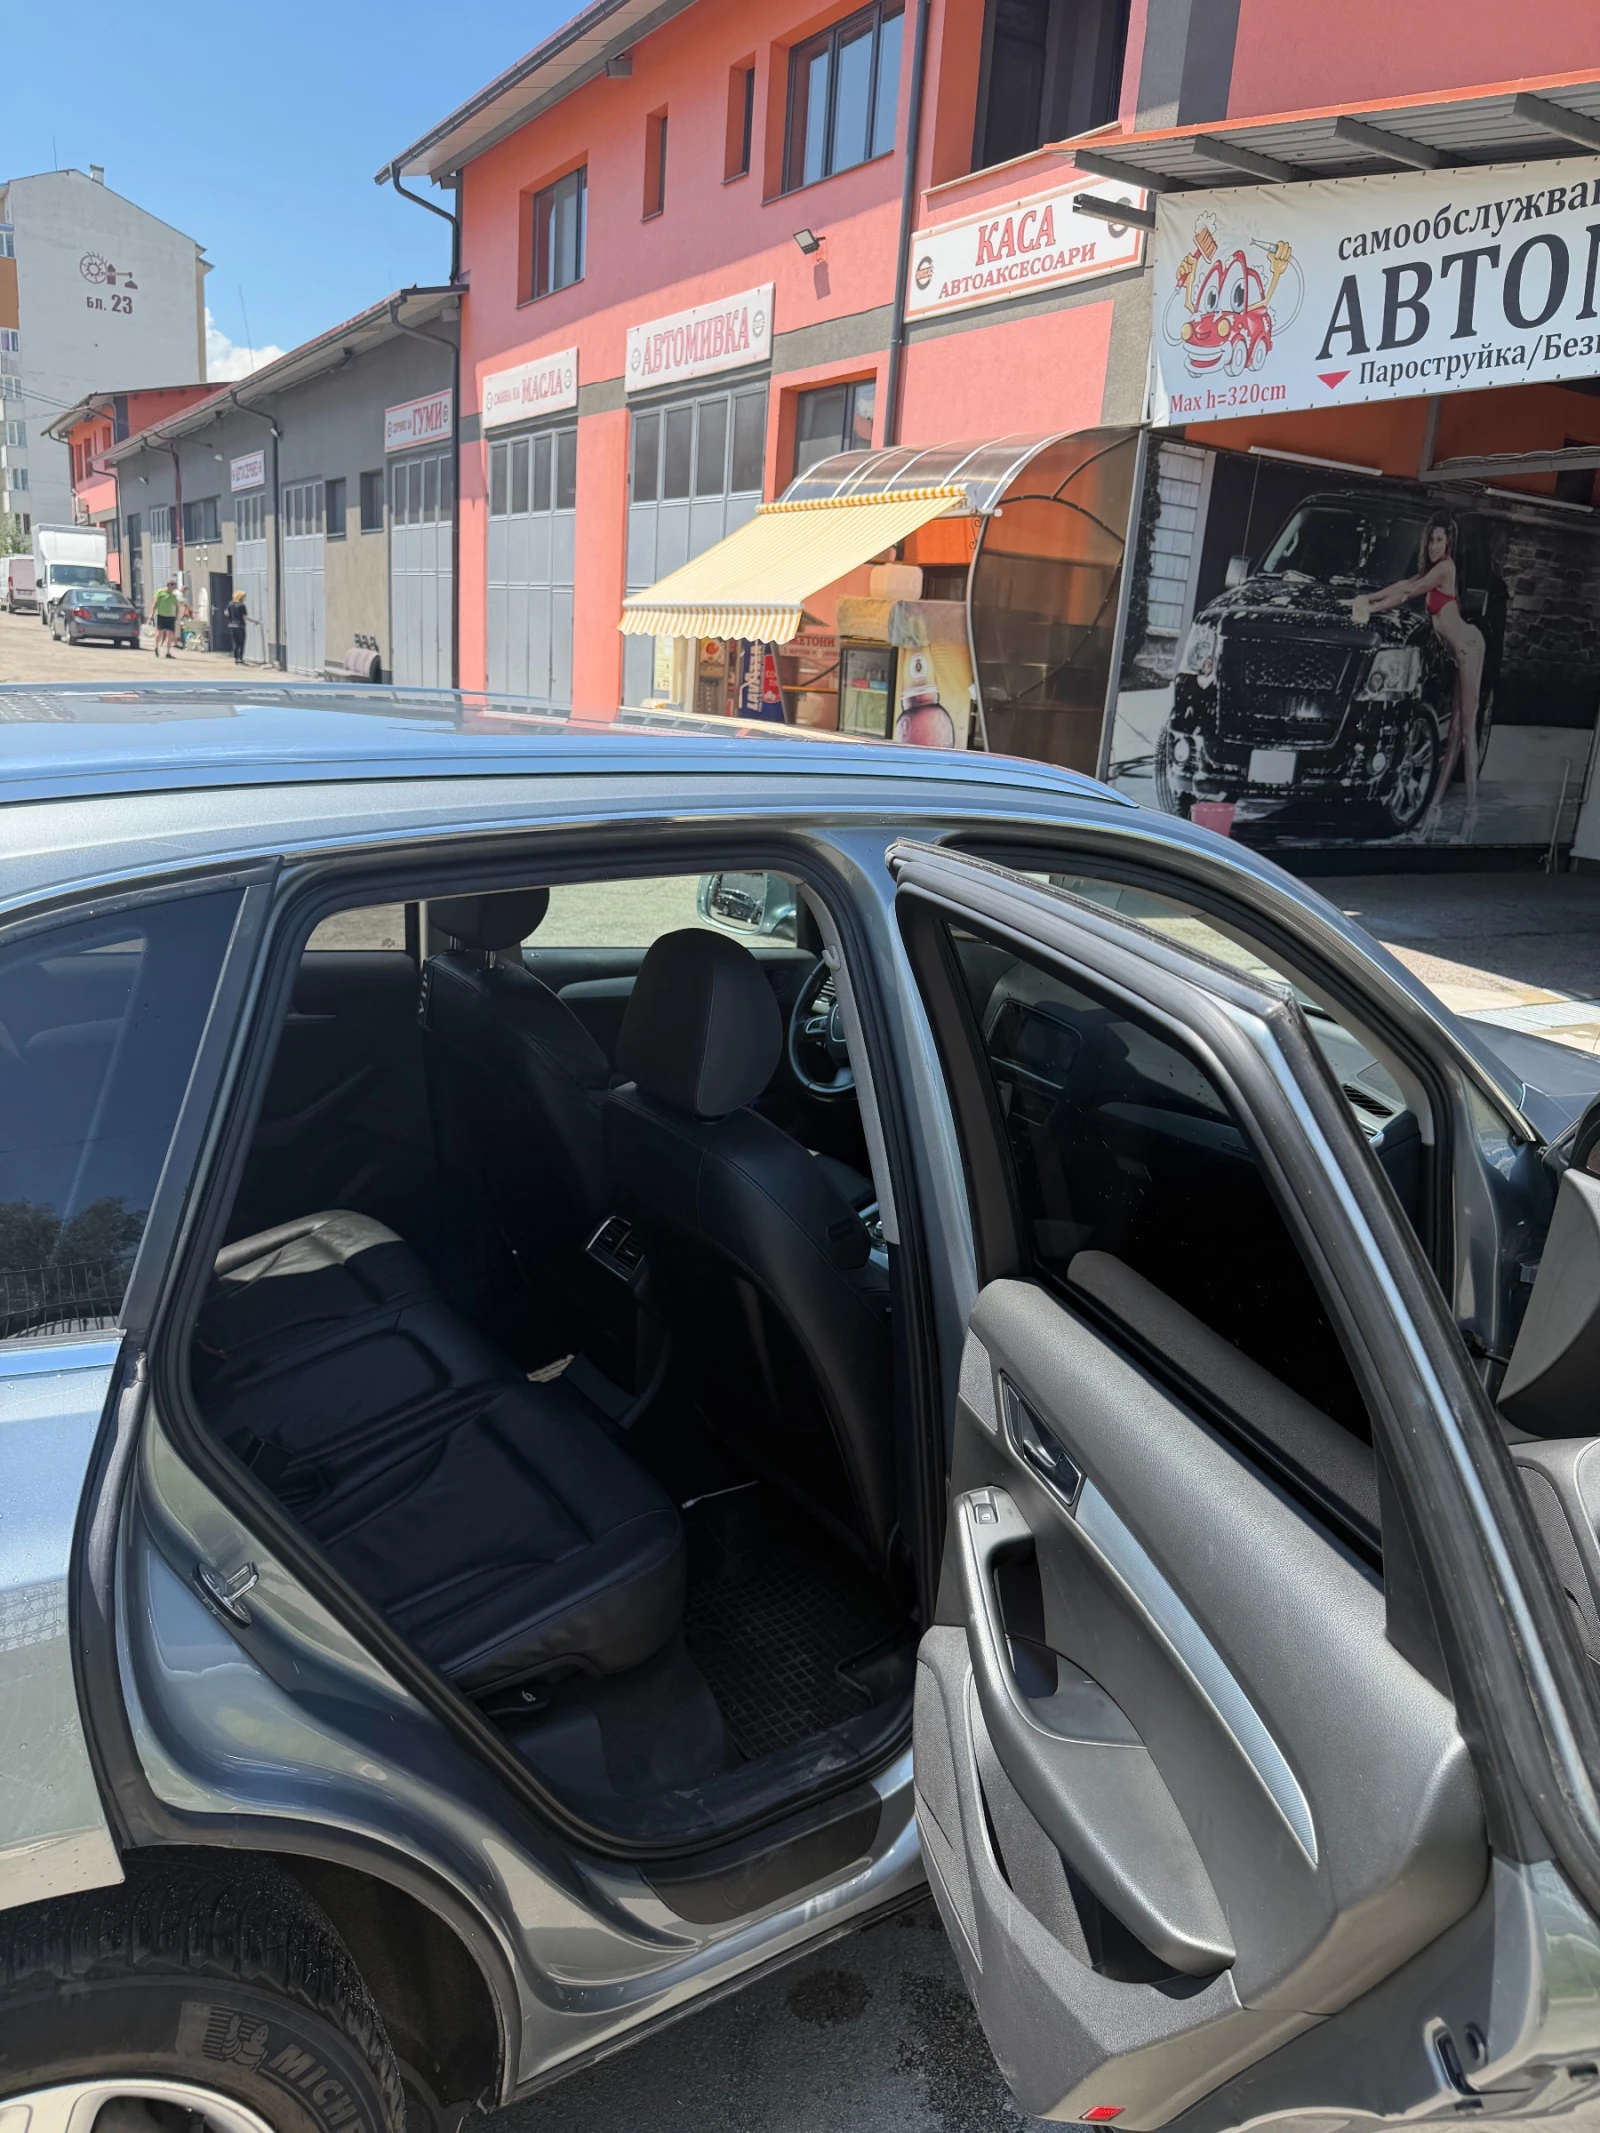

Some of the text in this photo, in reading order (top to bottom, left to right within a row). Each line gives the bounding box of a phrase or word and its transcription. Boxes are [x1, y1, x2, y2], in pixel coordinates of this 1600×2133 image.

[975, 205, 1056, 266] КАСА
[938, 242, 1097, 299] АВТОАКСЕСОАРИ
[111, 294, 133, 315] 23
[641, 307, 750, 376] АВТОМИВКА
[521, 368, 564, 404] МАСЛА
[1169, 383, 1286, 413] Max h=320cm
[412, 401, 443, 436] ГУМИ
